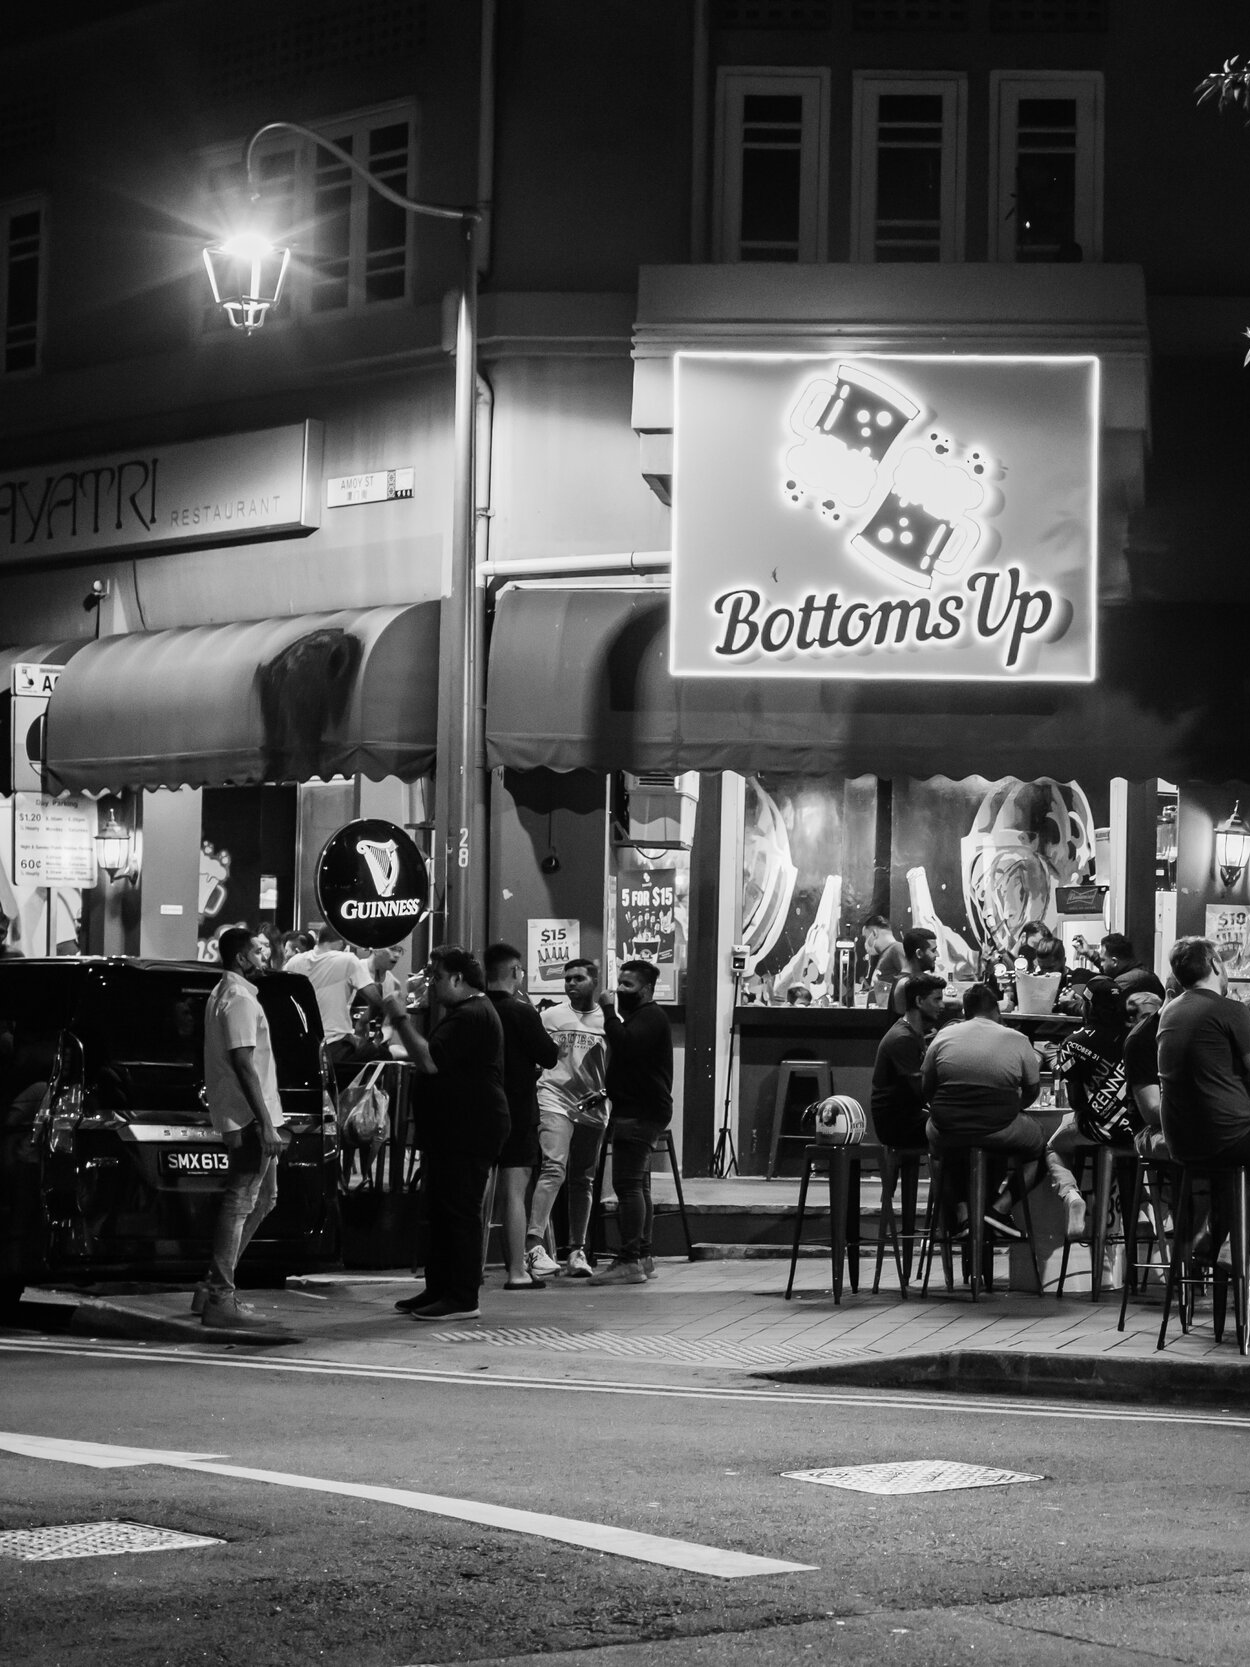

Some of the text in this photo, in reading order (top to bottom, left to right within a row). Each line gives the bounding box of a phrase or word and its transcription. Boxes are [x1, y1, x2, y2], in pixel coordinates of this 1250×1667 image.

[340, 475, 374, 489] AMOY ST
[170, 496, 280, 527] RESTAURANT
[714, 567, 1053, 667] Bottoms Up
[20, 813, 41, 822] $1.20
[458, 828, 469, 868] 28
[621, 886, 673, 907] 5 FOR $15
[340, 898, 420, 919] GUINNESS
[541, 928, 567, 943] $15
[1068, 1041, 1092, 1057] OCTOBER
[1092, 1053, 1100, 1061] 31
